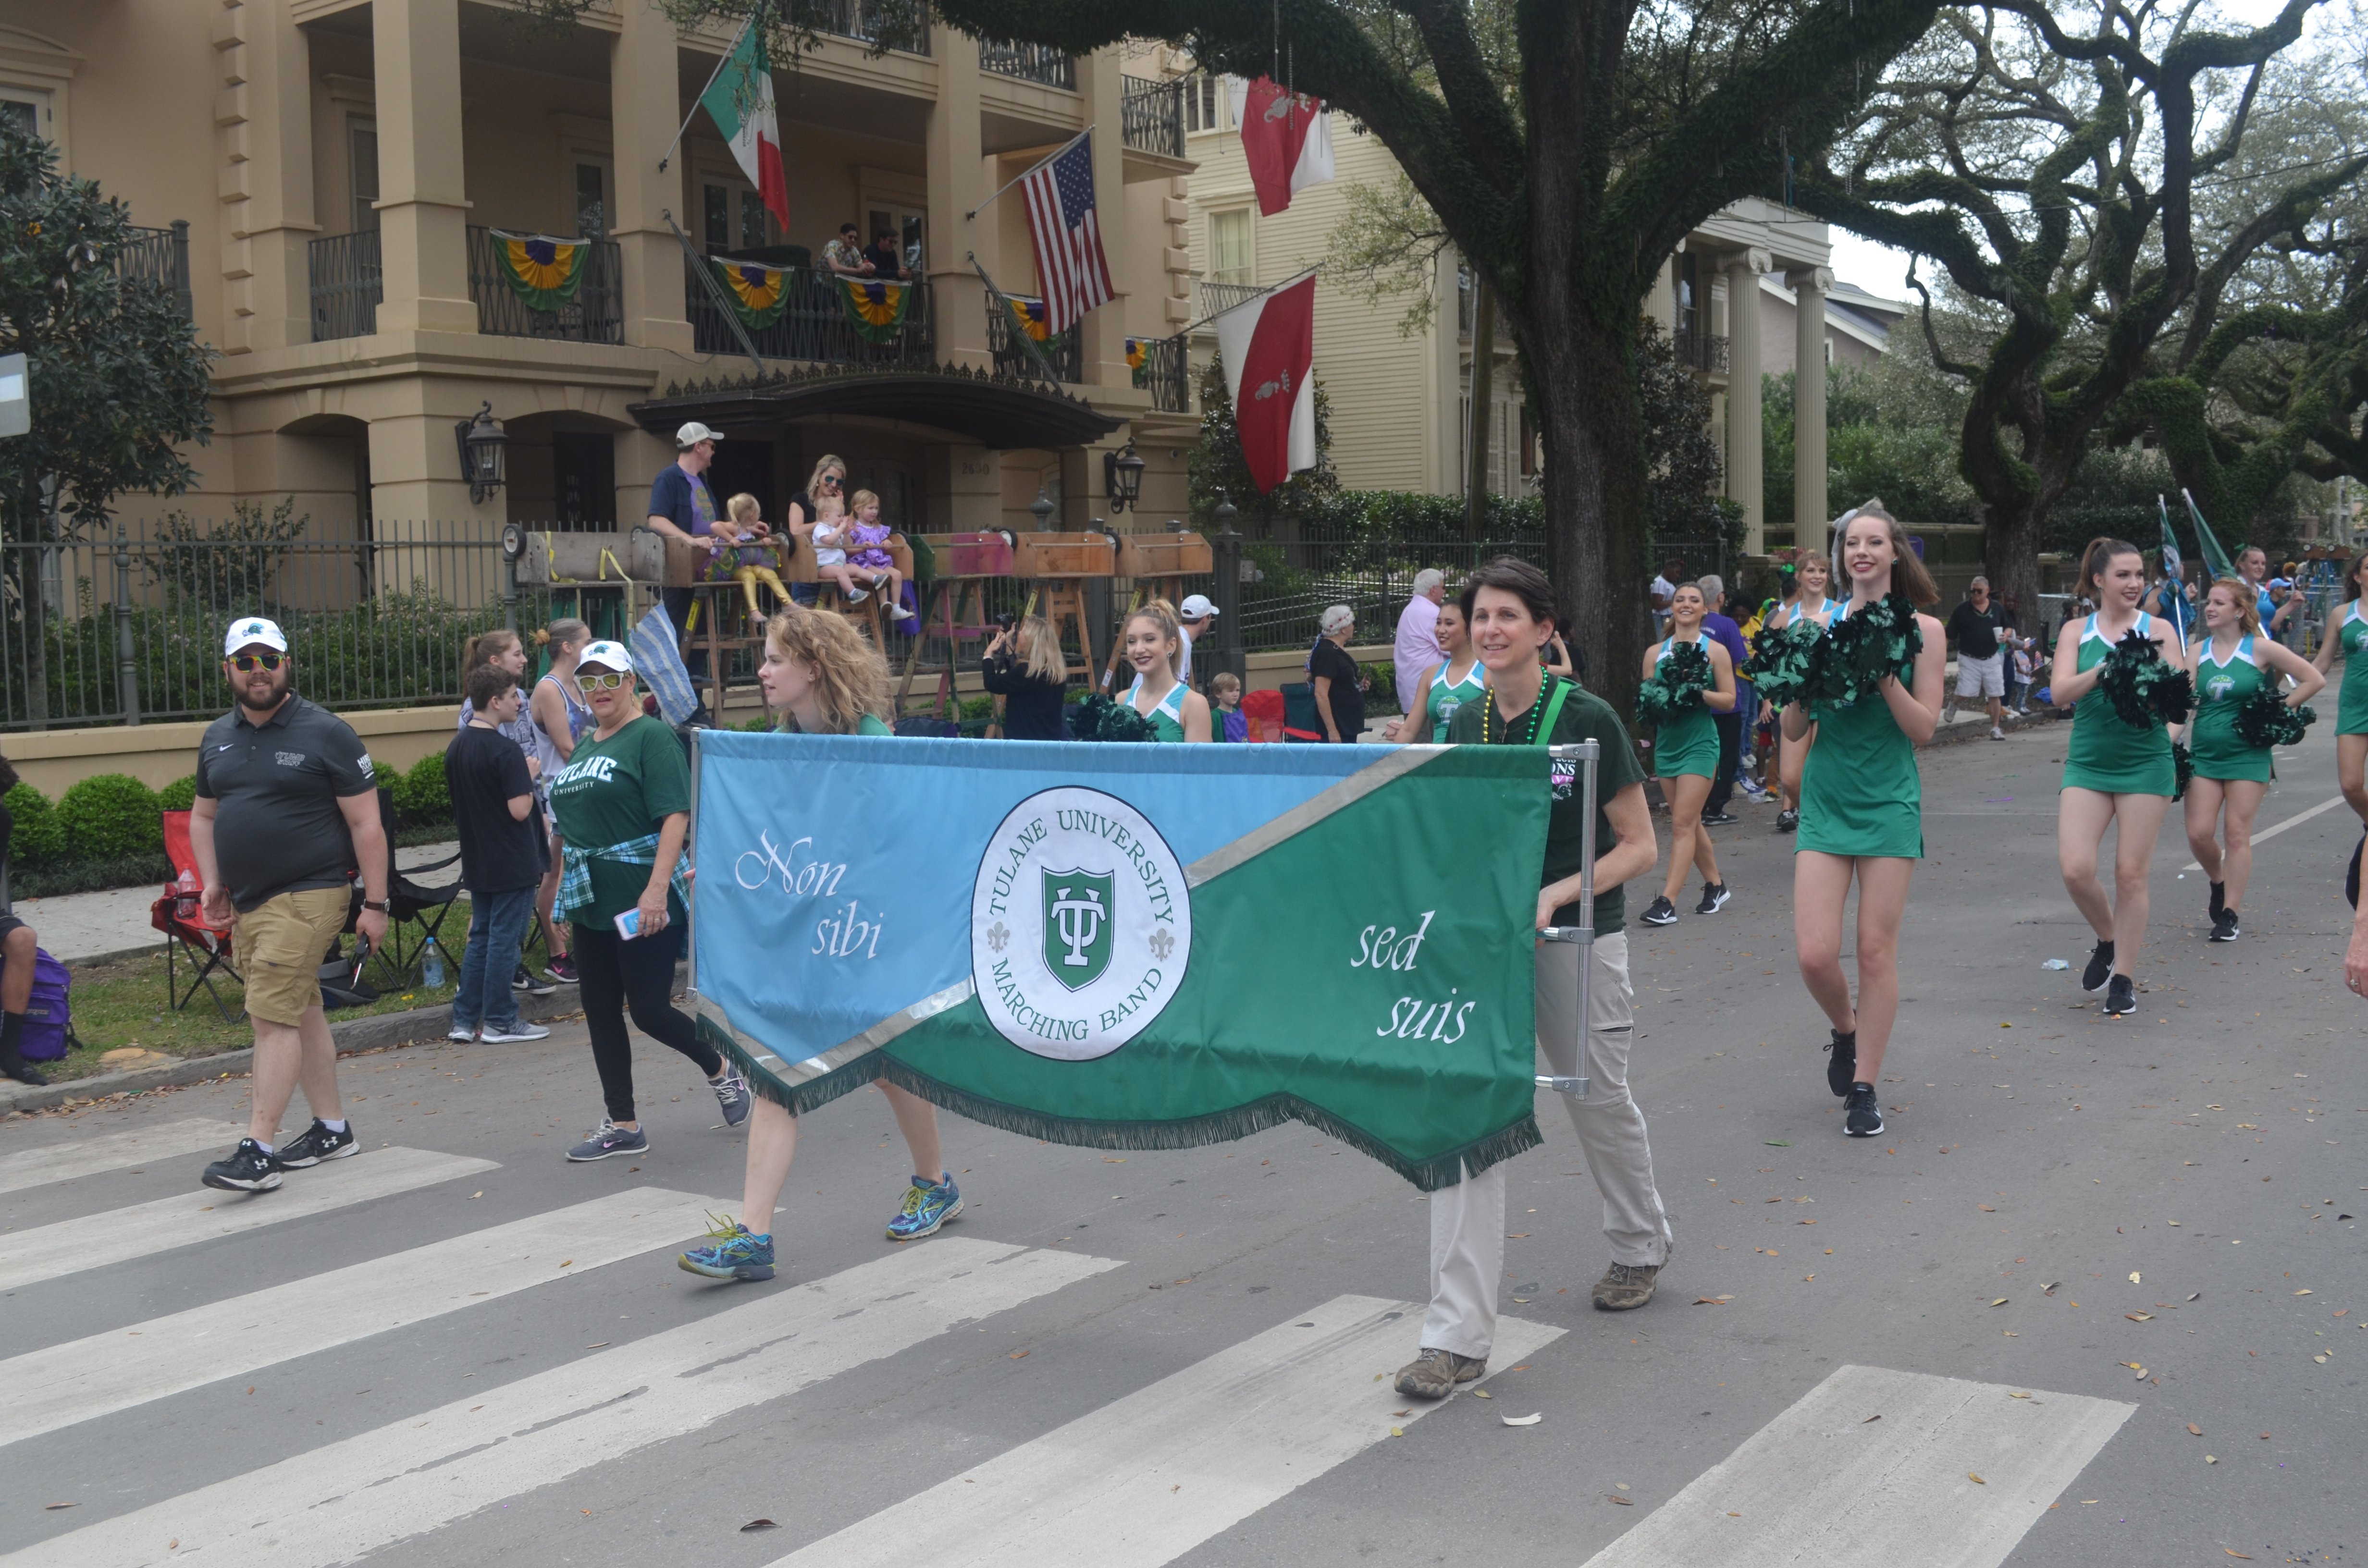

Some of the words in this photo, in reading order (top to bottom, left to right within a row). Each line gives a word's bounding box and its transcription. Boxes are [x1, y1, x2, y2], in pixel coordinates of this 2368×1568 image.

[551, 756, 617, 790] ULANE
[554, 781, 594, 796] UNIVERSITY
[735, 829, 847, 896] Non
[989, 818, 1048, 916] TULANE
[1057, 809, 1173, 925] UNIVERSITY
[812, 900, 884, 960] sibi
[1351, 910, 1435, 971] sed
[992, 957, 1089, 1041] MARCHING
[1098, 968, 1161, 1033] BAND
[1377, 988, 1476, 1044] suis
